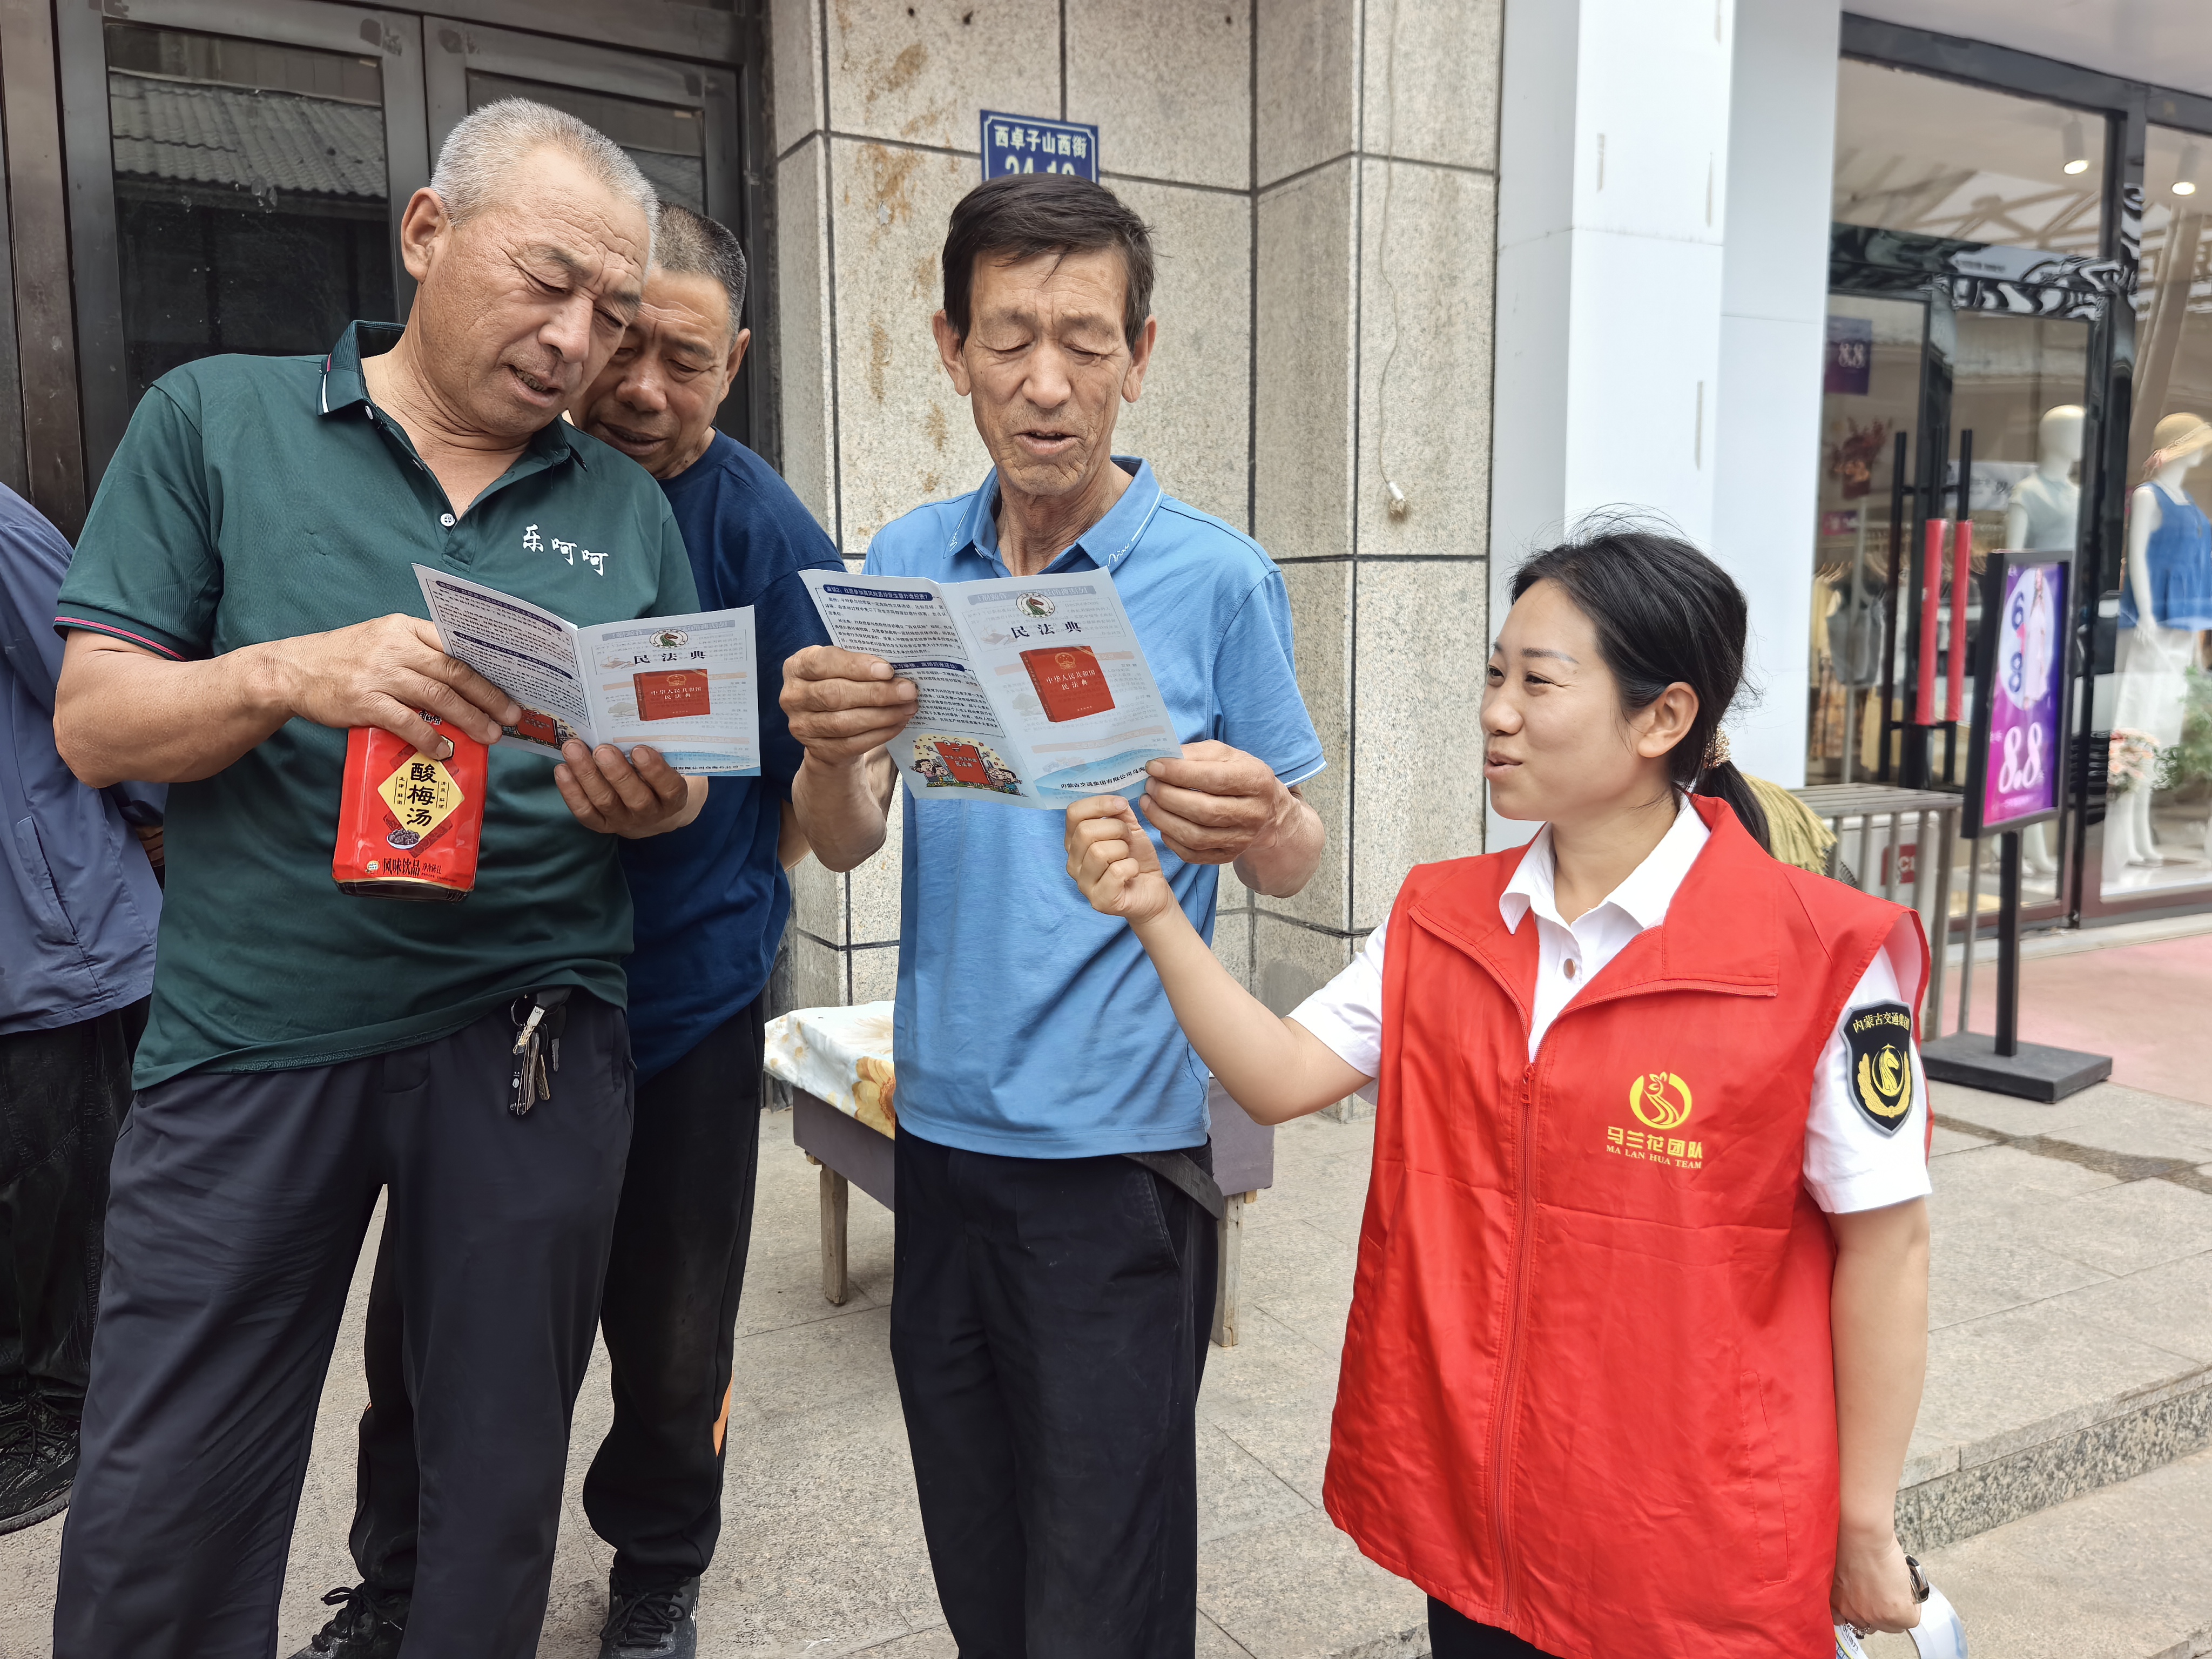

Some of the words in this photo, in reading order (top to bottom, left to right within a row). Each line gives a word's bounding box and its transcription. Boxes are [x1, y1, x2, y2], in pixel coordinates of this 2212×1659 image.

[994, 125, 1087, 159] 西卓子山西街
[1011, 621, 1082, 638] 民法典
[634, 650, 706, 664] 民法典
[1046, 669, 1096, 684] 中华人民共和国
[1061, 679, 1088, 690] 民法典
[651, 686, 702, 696] 中华人民共和国
[407, 763, 437, 826] 酸梅汤
[383, 858, 420, 876] 风味饮品
[1852, 1011, 1910, 1034] 内蒙古交通集团
[1607, 1126, 1703, 1158] 马兰花团队
[1606, 1145, 1621, 1155] MA
[1625, 1149, 1645, 1160] LAN
[1649, 1154, 1671, 1165] HUA
[1675, 1159, 1702, 1169] TEAM
